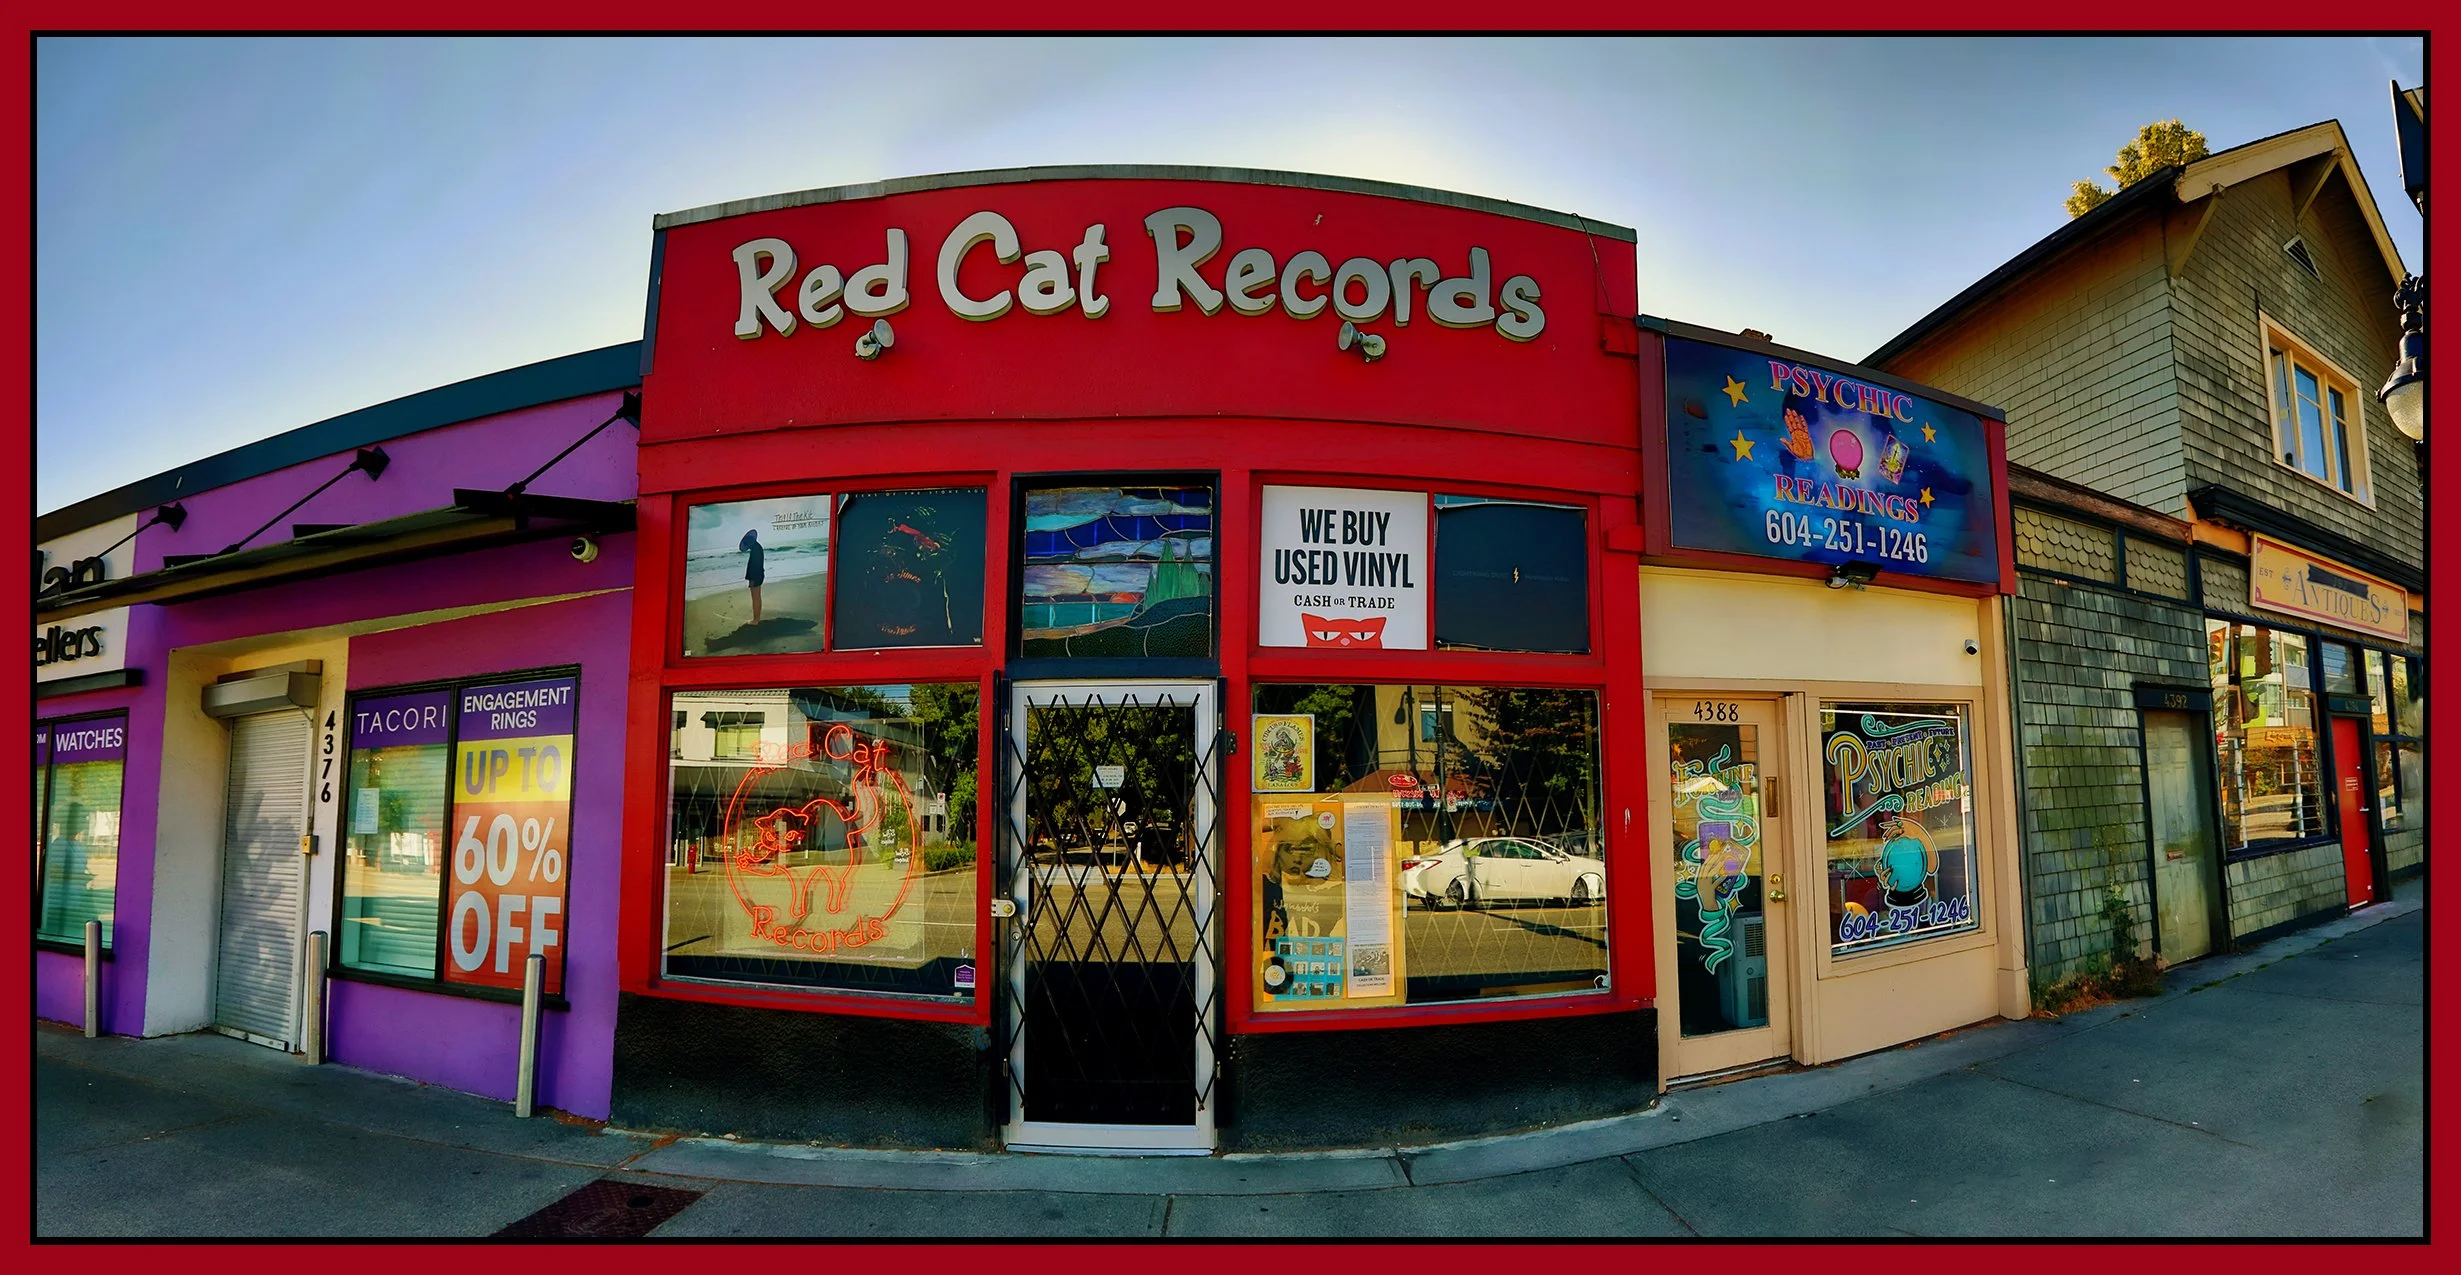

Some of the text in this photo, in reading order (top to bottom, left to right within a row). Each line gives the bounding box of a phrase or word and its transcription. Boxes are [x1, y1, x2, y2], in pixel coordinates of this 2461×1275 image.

[732, 206, 1545, 343] Red Cat Records
[1768, 360, 1914, 424] PSYCHIC
[1772, 473, 1920, 524] READINGS
[1300, 508, 1391, 546] WE BUY
[1765, 509, 1929, 564] 604-251-1246
[1274, 549, 1414, 588] USED VINYL
[2259, 567, 2273, 579] EST
[1294, 594, 1396, 610] CASH OR TRADE
[2292, 569, 2381, 625] ANTIQUES
[356, 704, 448, 735] TACORI
[464, 686, 571, 713] ENGAGEMENT
[491, 710, 537, 731] RINGS
[1693, 701, 1739, 722] 4388
[56, 728, 123, 752] WATCHES
[320, 710, 336, 803] 4376
[825, 724, 888, 771] Cat
[1866, 727, 1955, 750] PAST PRESENT FUTURE
[465, 744, 562, 796] UP TO
[1826, 731, 1936, 818] PSYCHIC
[454, 813, 562, 886] 60%
[450, 890, 562, 974] OFF
[750, 905, 884, 953] Records
[1839, 895, 1971, 942] 604-251-1246
